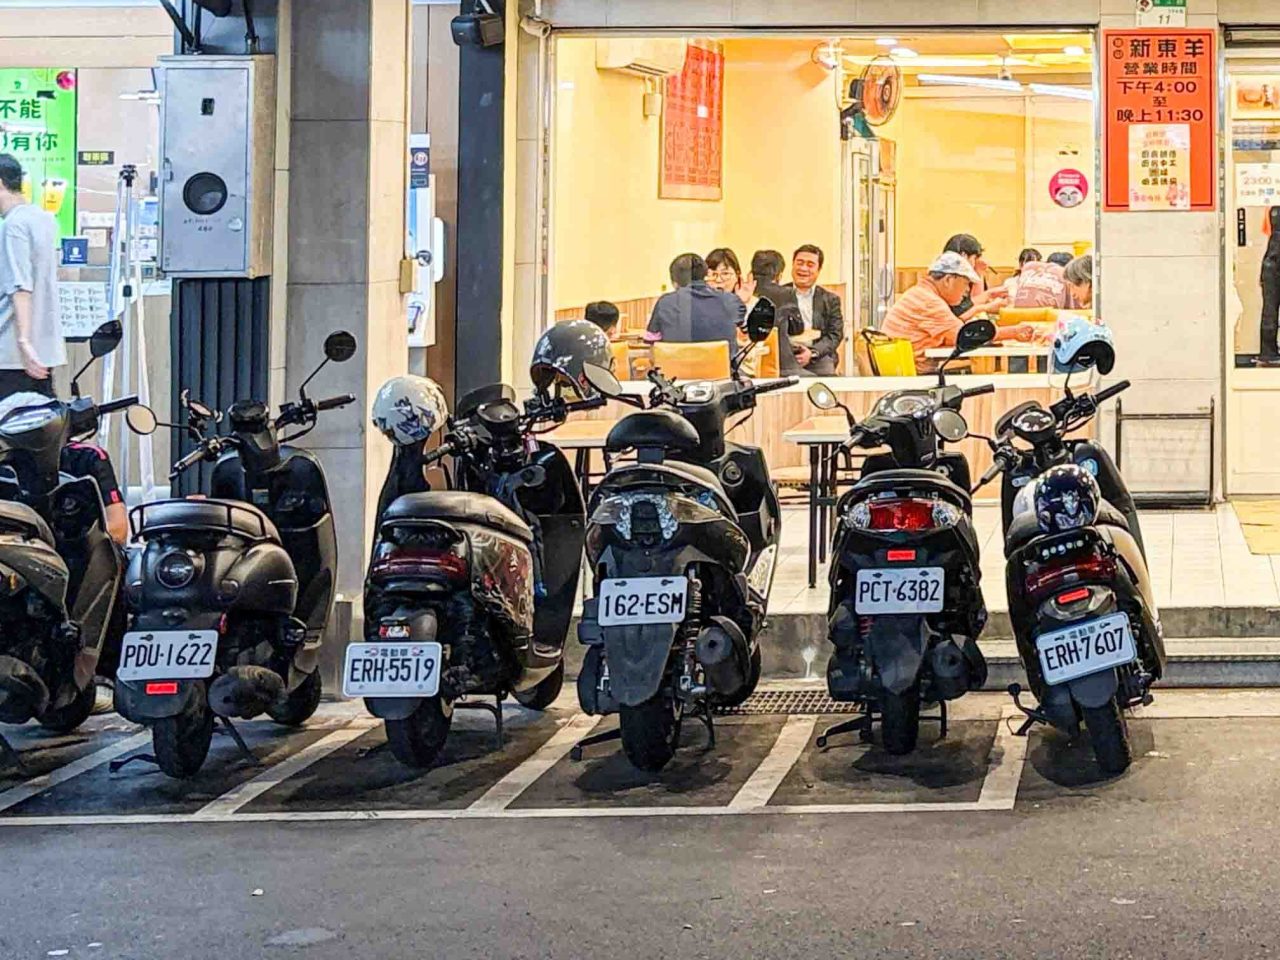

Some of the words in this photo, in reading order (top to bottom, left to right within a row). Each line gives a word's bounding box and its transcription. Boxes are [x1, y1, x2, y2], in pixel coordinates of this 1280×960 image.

[1130, 38, 1204, 58] 新東羊
[1124, 62, 1197, 75] 營業時間
[1117, 81, 1197, 94] 下午4:00
[1153, 96, 1168, 107] 至
[1117, 109, 1203, 122] 晚上11:30
[859, 580, 940, 603] PCT-6382
[605, 592, 683, 617] 162-ESM
[123, 643, 212, 668] PDU-1622
[1045, 628, 1124, 671] ERH-7607
[350, 657, 434, 682] ERH-5519
